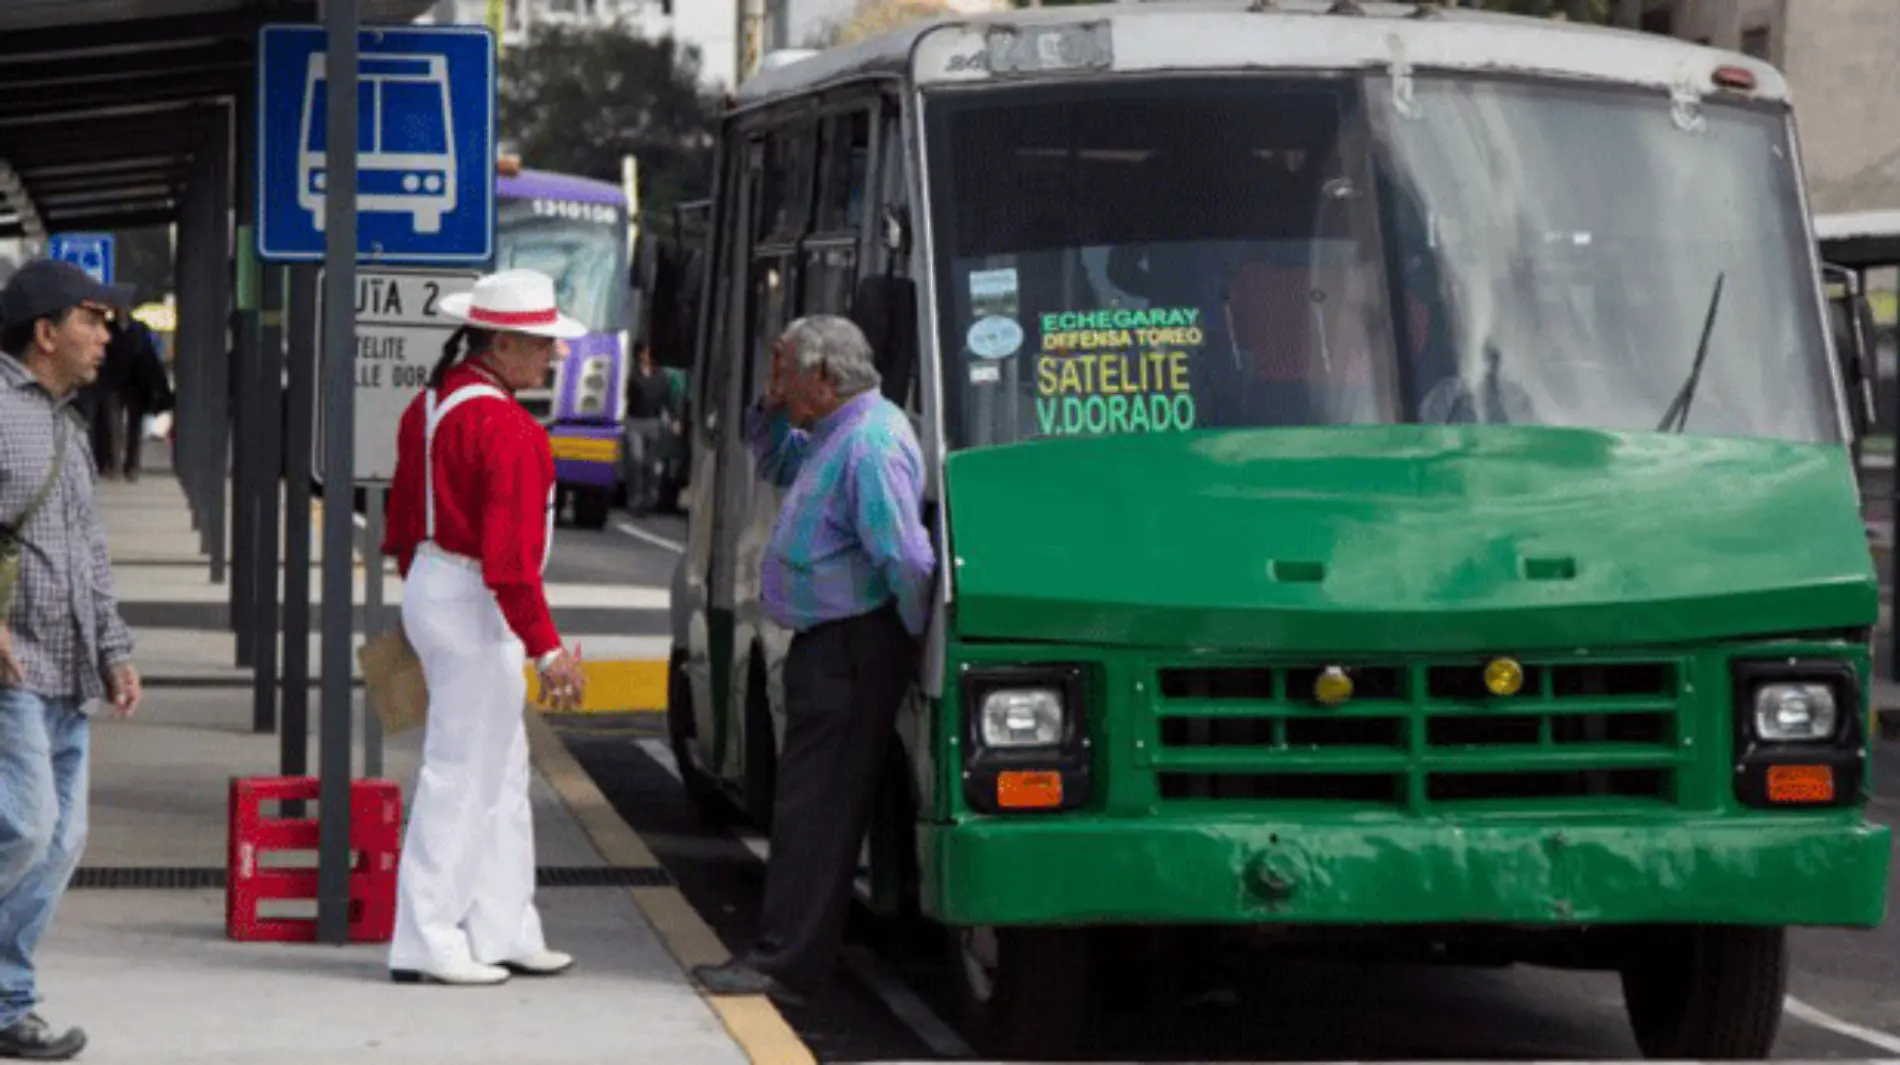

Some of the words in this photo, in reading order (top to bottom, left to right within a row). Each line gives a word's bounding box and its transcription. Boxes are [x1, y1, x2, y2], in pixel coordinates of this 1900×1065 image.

[355, 279, 402, 314] UTA
[422, 281, 440, 316] 2
[1042, 309, 1198, 330] ECHEGARAY
[355, 336, 405, 359] TELITE
[1044, 330, 1132, 349] DEFENSA
[1136, 326, 1202, 346] TOREO
[392, 365, 427, 387] DOR
[1038, 352, 1190, 394] SATELITE
[1036, 394, 1194, 434] V.DORADO
